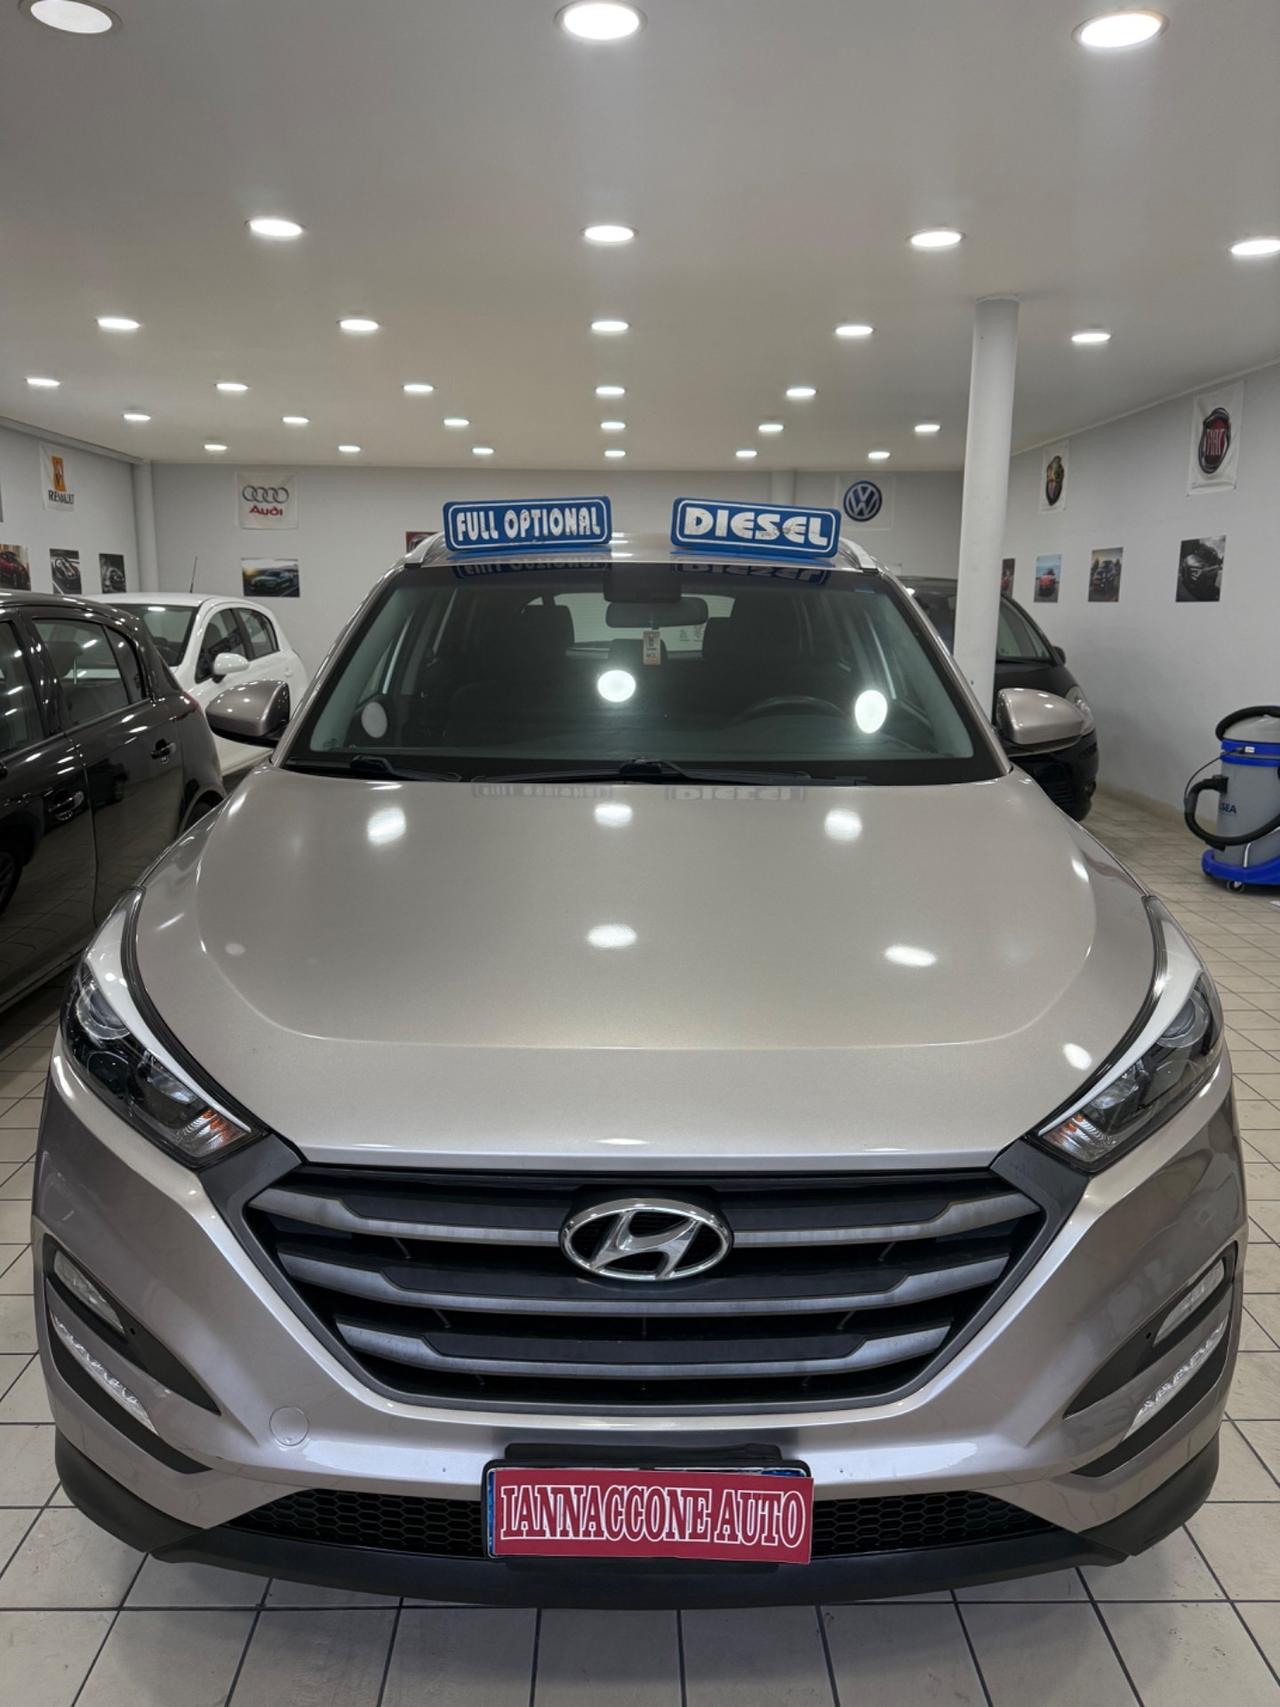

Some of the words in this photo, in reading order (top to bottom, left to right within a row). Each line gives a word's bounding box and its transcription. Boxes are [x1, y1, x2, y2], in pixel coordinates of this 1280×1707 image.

[249, 505, 283, 516] Audi
[456, 511, 499, 542] FULL
[504, 506, 601, 540] OPTIONAL
[684, 507, 829, 547] DIESEL
[500, 1484, 712, 1543] IANNACCONE
[714, 1488, 806, 1549] AUTO
